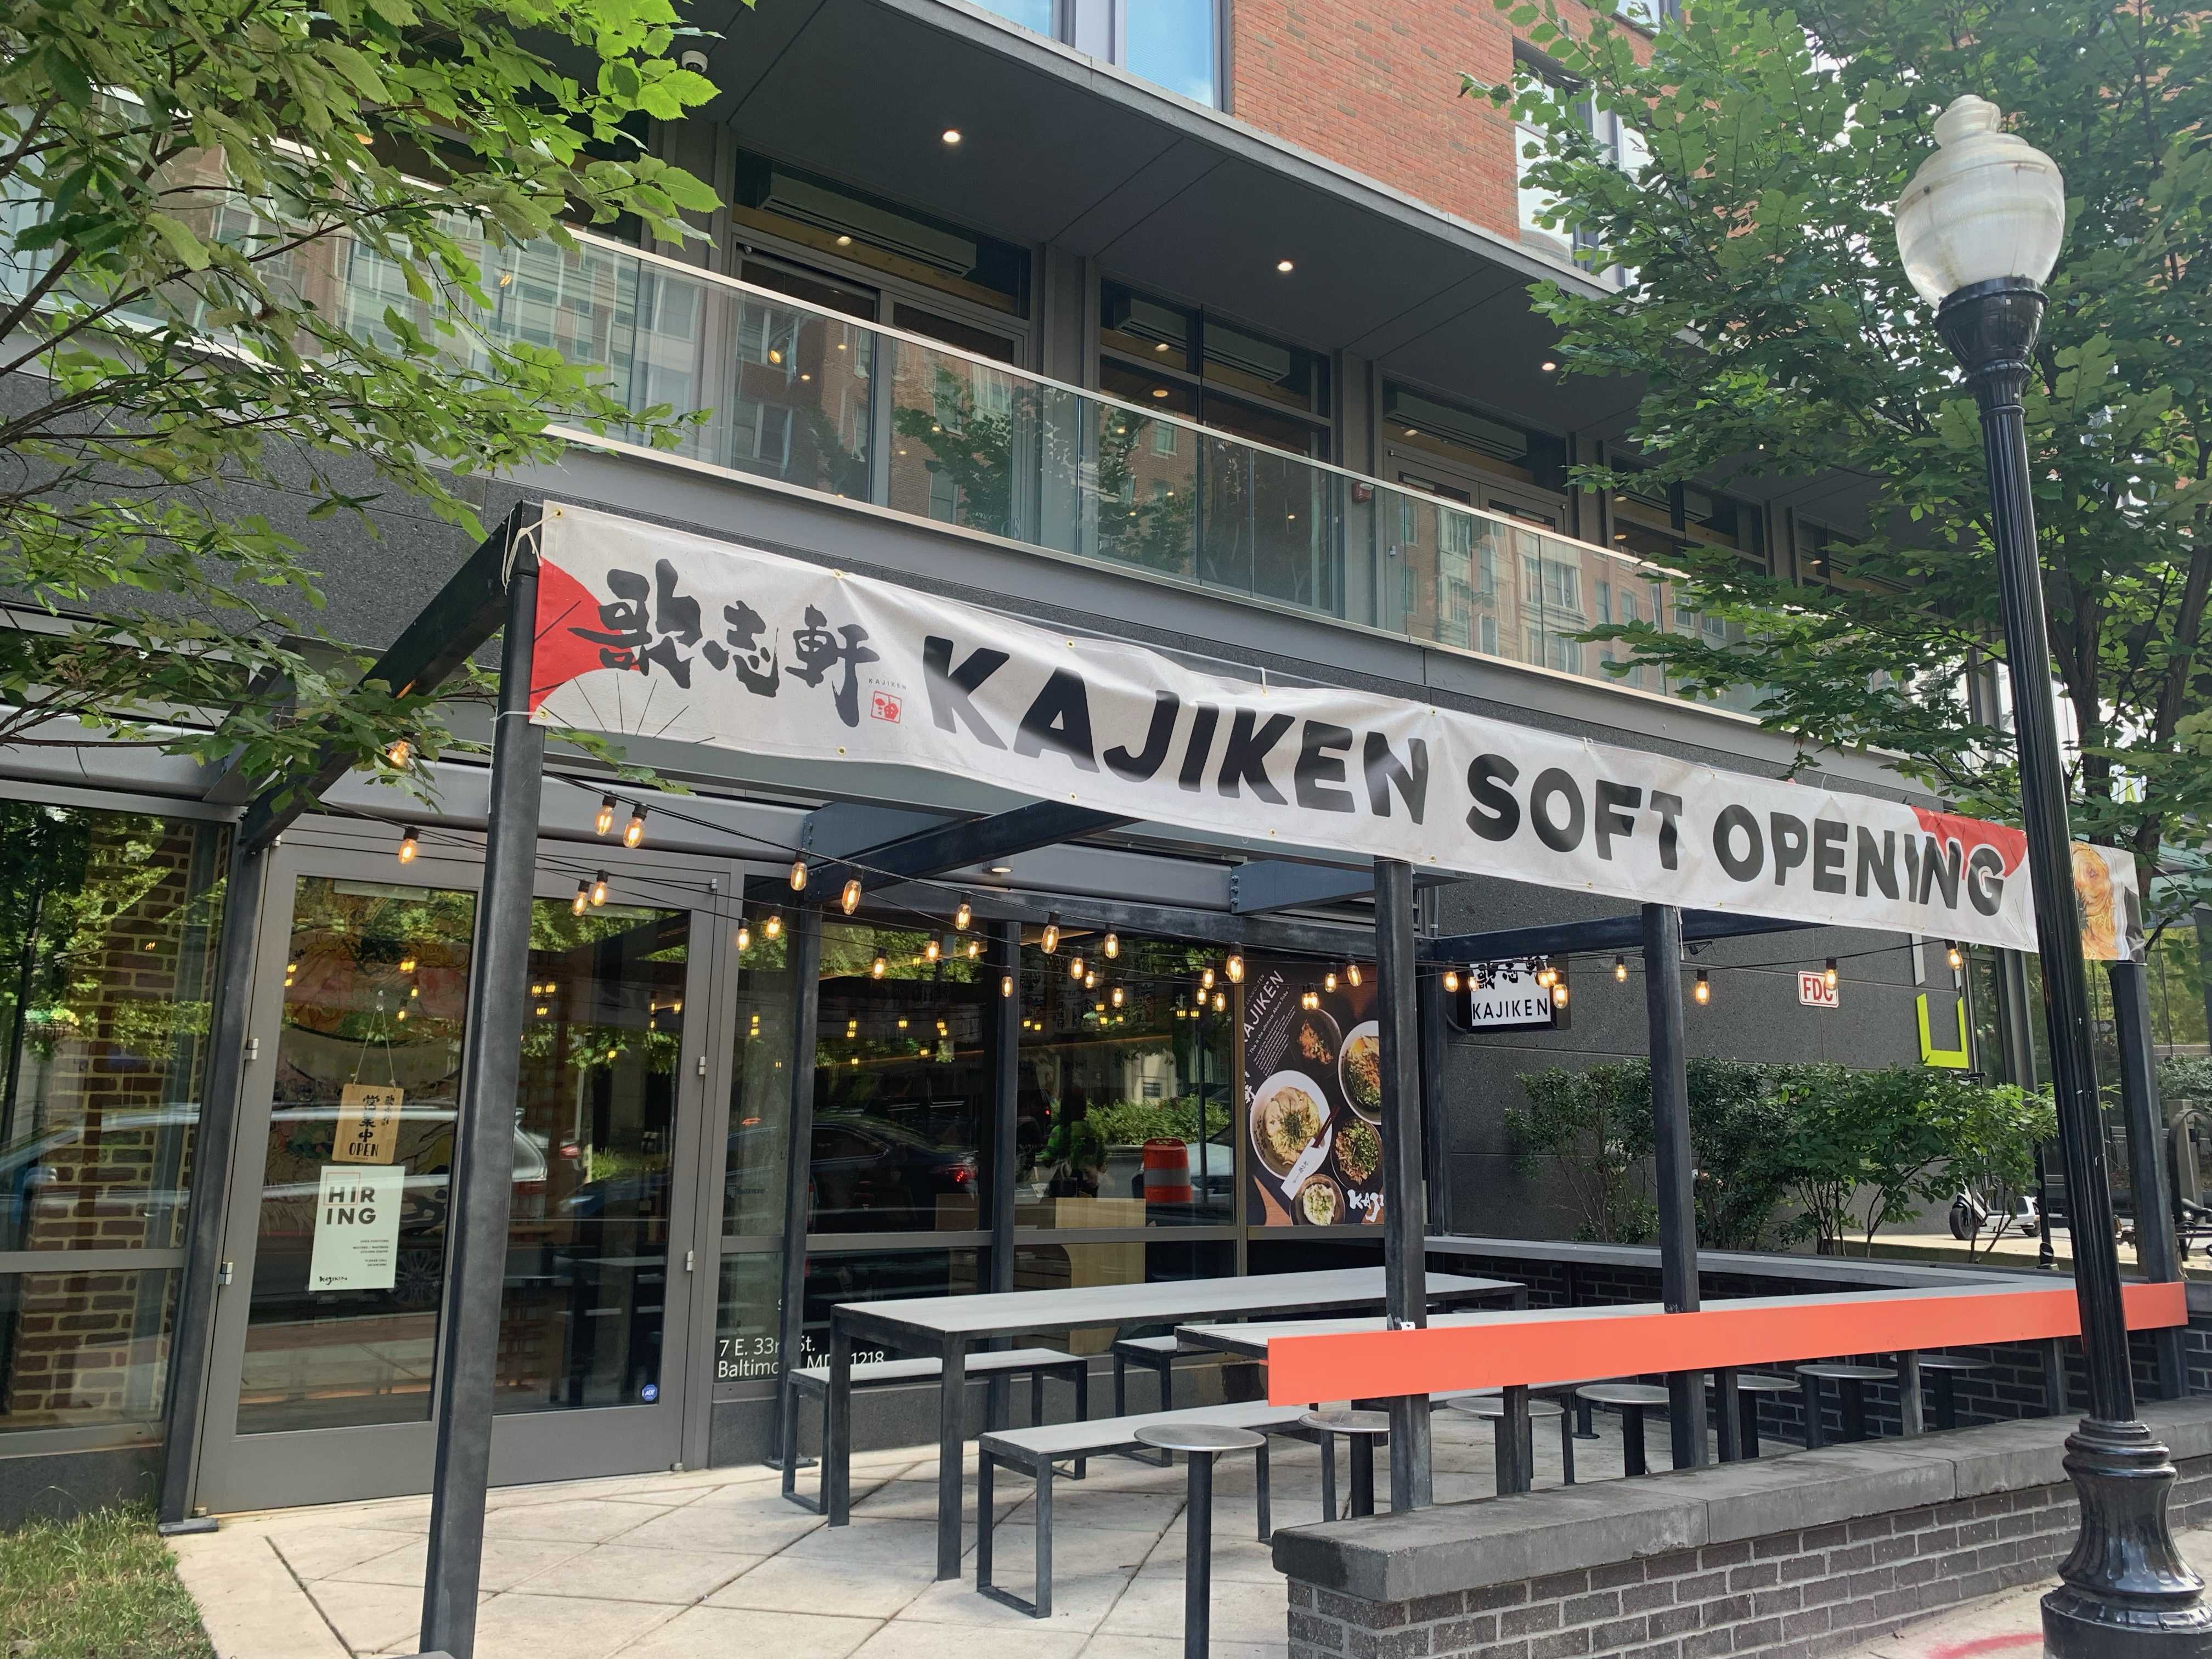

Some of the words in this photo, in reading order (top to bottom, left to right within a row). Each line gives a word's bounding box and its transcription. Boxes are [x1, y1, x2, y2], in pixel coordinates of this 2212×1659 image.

[869, 678, 906, 690] KAJIKEN
[923, 635, 1429, 826] KAJIKEN
[1465, 753, 1683, 870] SOFT
[1713, 803, 2005, 916] OPENING
[1244, 970, 1284, 1042] AJIKEN
[1472, 998, 1548, 1020] KAJIKEN
[349, 1142, 379, 1156] OPEN
[329, 1187, 375, 1203] HIR
[1347, 1189, 1384, 1222] KAJI
[326, 1208, 376, 1224] ING
[719, 1340, 730, 1357] 7
[735, 1339, 748, 1356] E.
[753, 1338, 780, 1355] 33r
[718, 1359, 779, 1378] Baltimo
[851, 1351, 884, 1365] 1218
